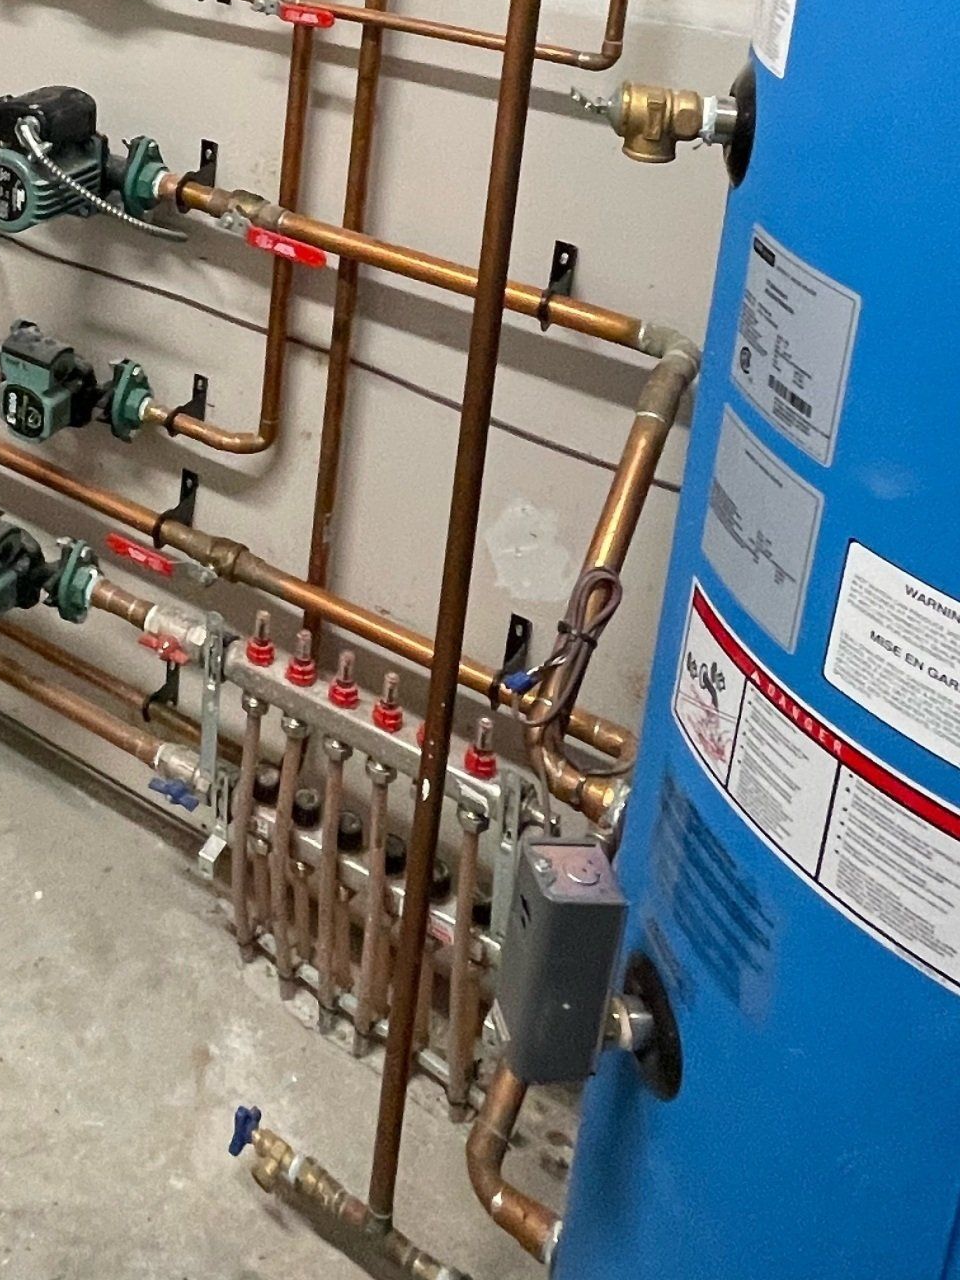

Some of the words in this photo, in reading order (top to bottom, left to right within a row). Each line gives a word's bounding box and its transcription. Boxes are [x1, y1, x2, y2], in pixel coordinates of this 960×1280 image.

[870, 630, 902, 658] MISE
[904, 652, 924, 671] EN
[767, 683, 843, 756] DANGER
